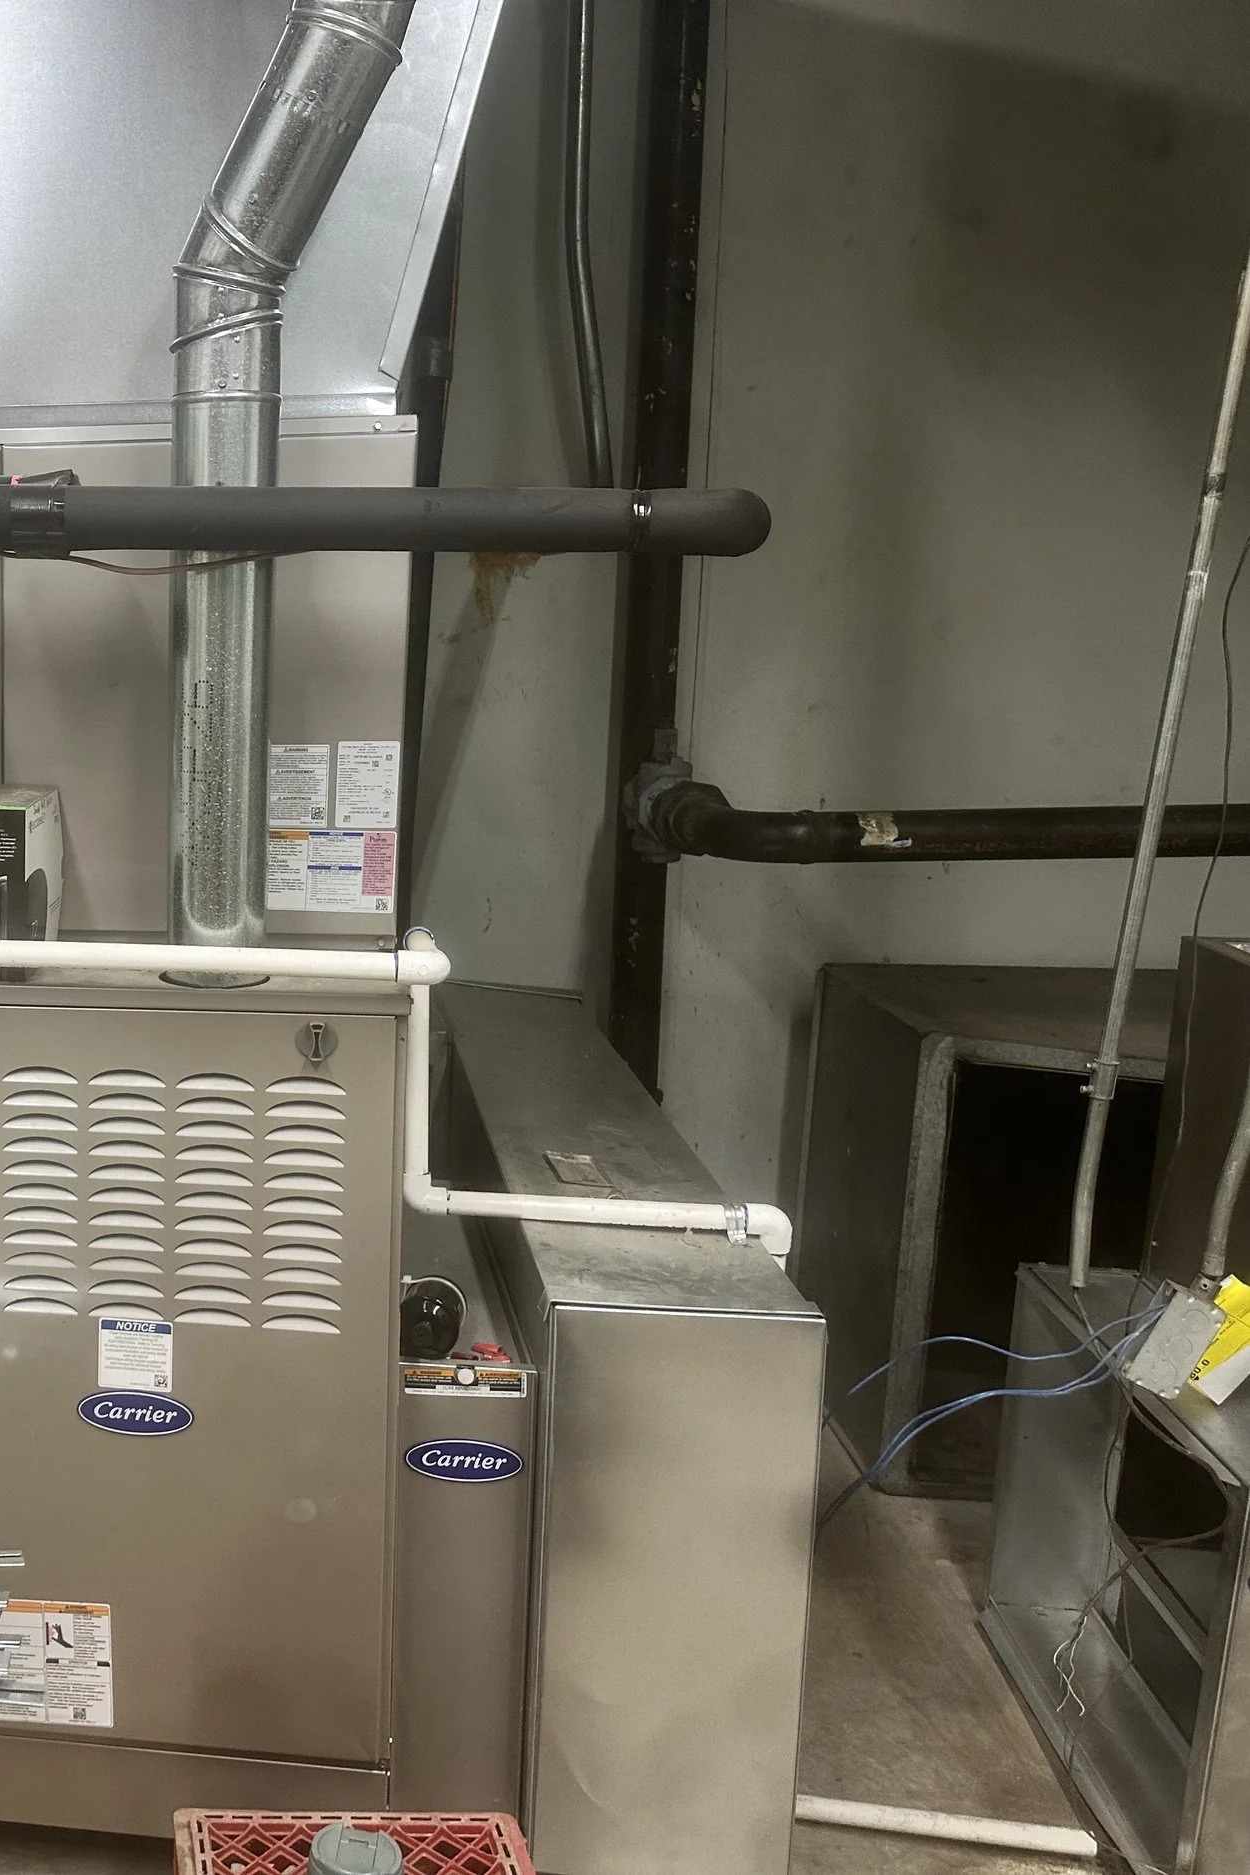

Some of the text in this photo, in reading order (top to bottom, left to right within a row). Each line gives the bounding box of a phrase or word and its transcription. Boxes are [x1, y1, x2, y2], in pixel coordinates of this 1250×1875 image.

[116, 1321, 157, 1333] NOTICE
[94, 1401, 178, 1424] Carrier
[421, 1449, 508, 1470] Carrier
